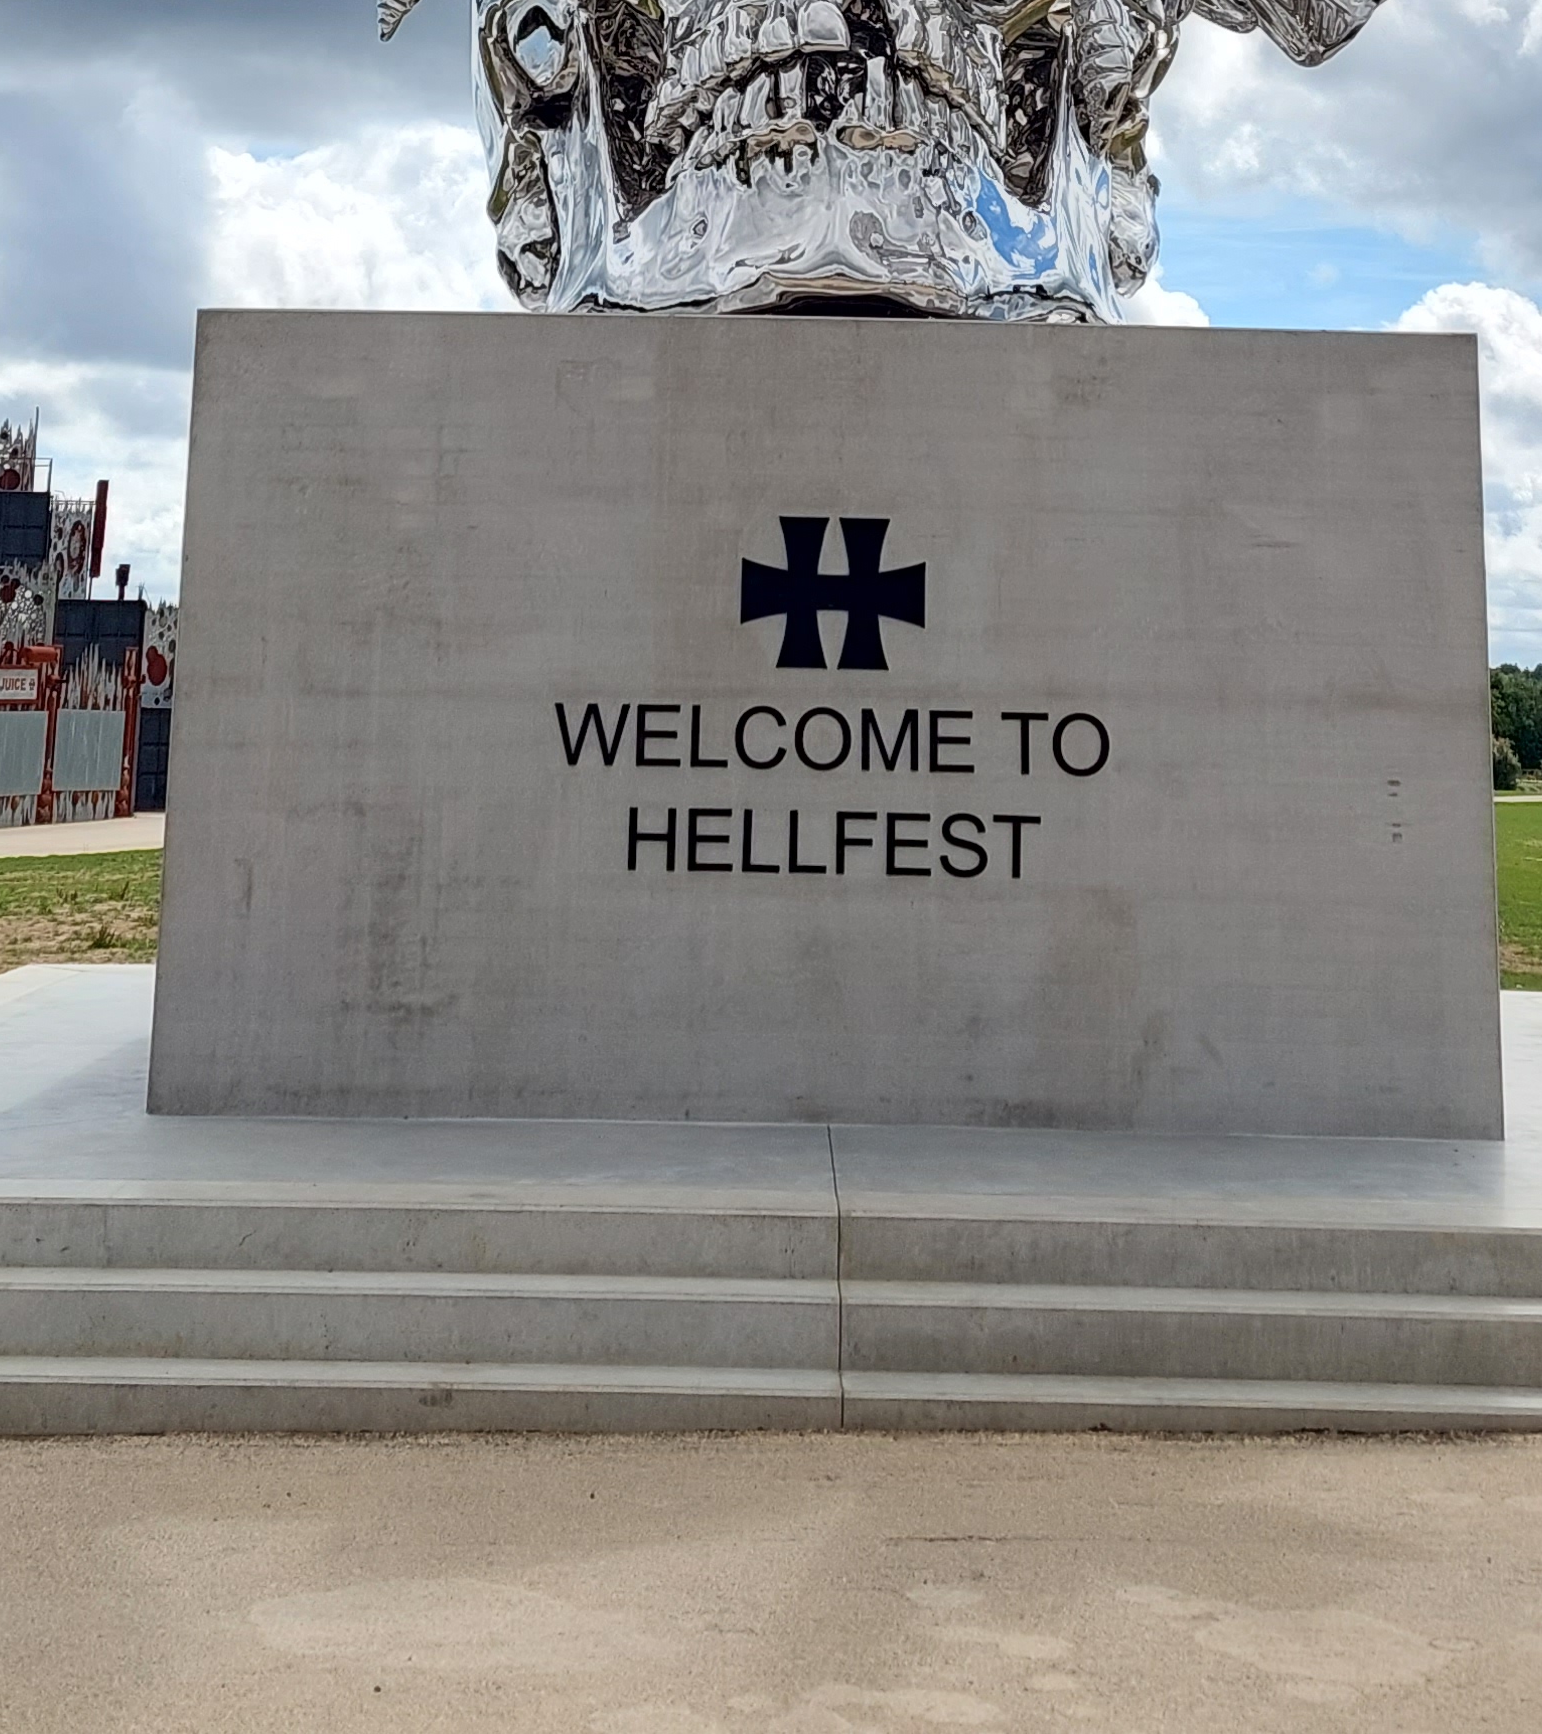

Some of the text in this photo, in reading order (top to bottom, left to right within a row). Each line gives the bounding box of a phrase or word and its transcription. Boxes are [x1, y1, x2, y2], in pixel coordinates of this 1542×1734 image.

[0, 677, 27, 692] JUICE
[554, 702, 1111, 777] WELCOME TO
[627, 806, 1042, 879] HELLFEST
